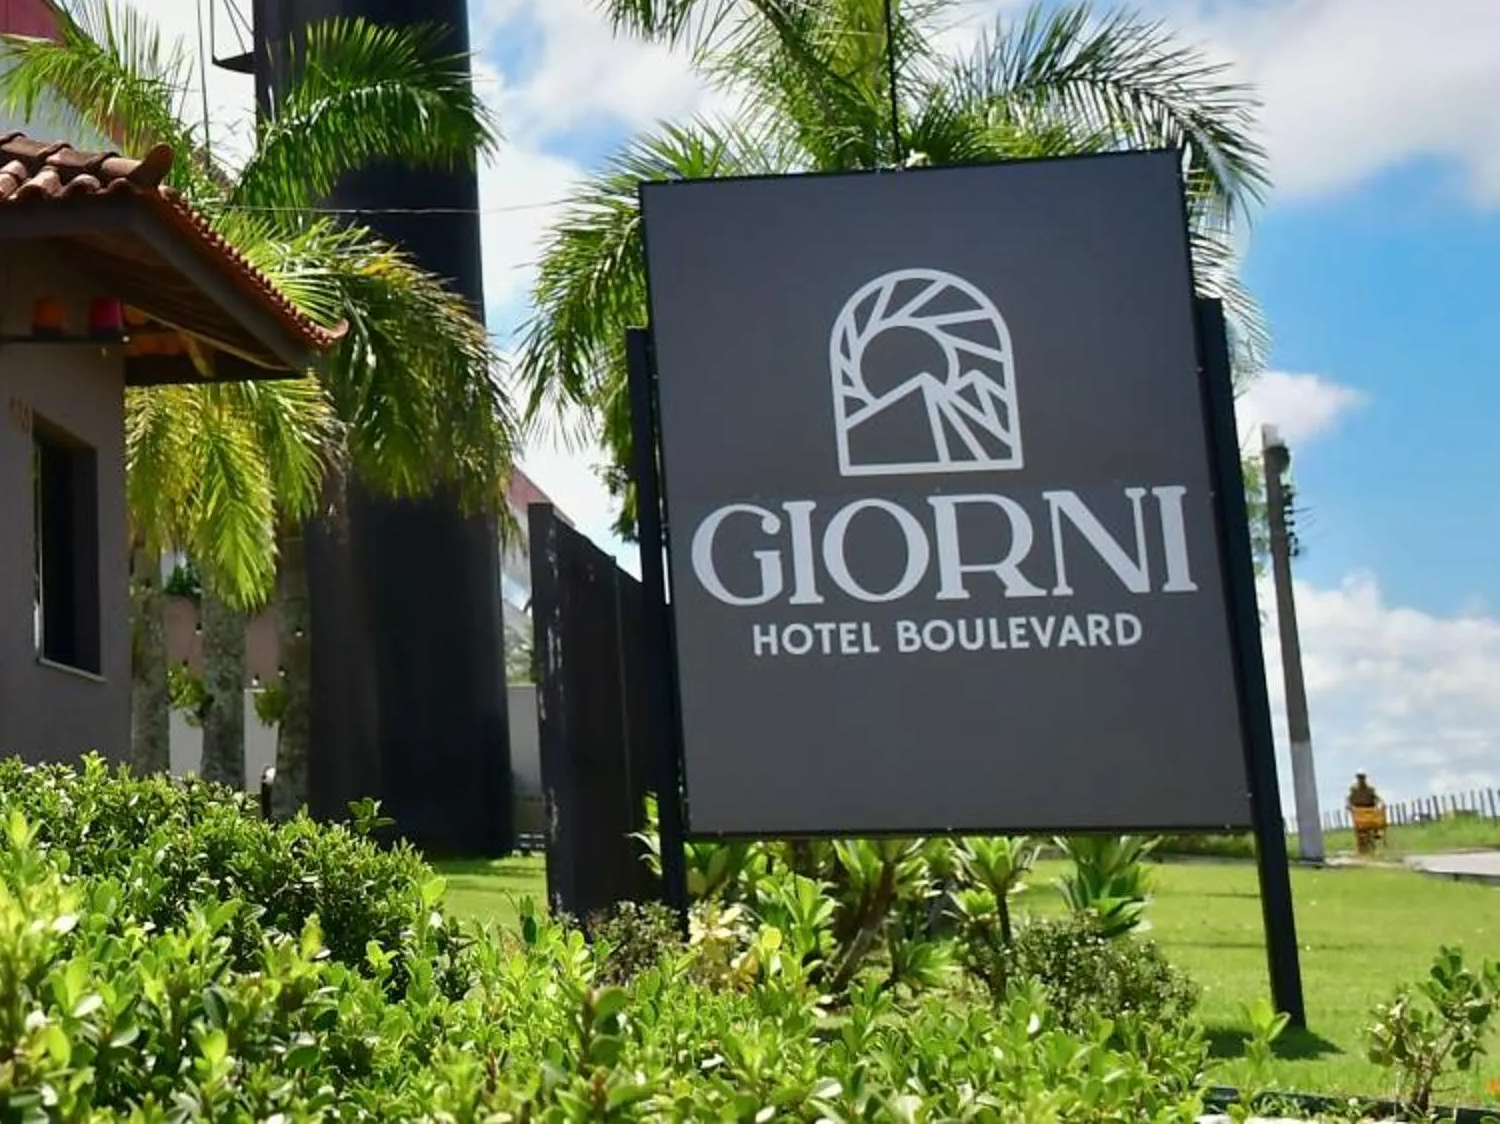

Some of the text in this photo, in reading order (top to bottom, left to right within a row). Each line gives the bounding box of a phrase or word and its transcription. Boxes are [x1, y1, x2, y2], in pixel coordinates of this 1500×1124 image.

[691, 484, 1200, 608] GIORNI
[751, 612, 1144, 657] HOTEL BOULEVARD
